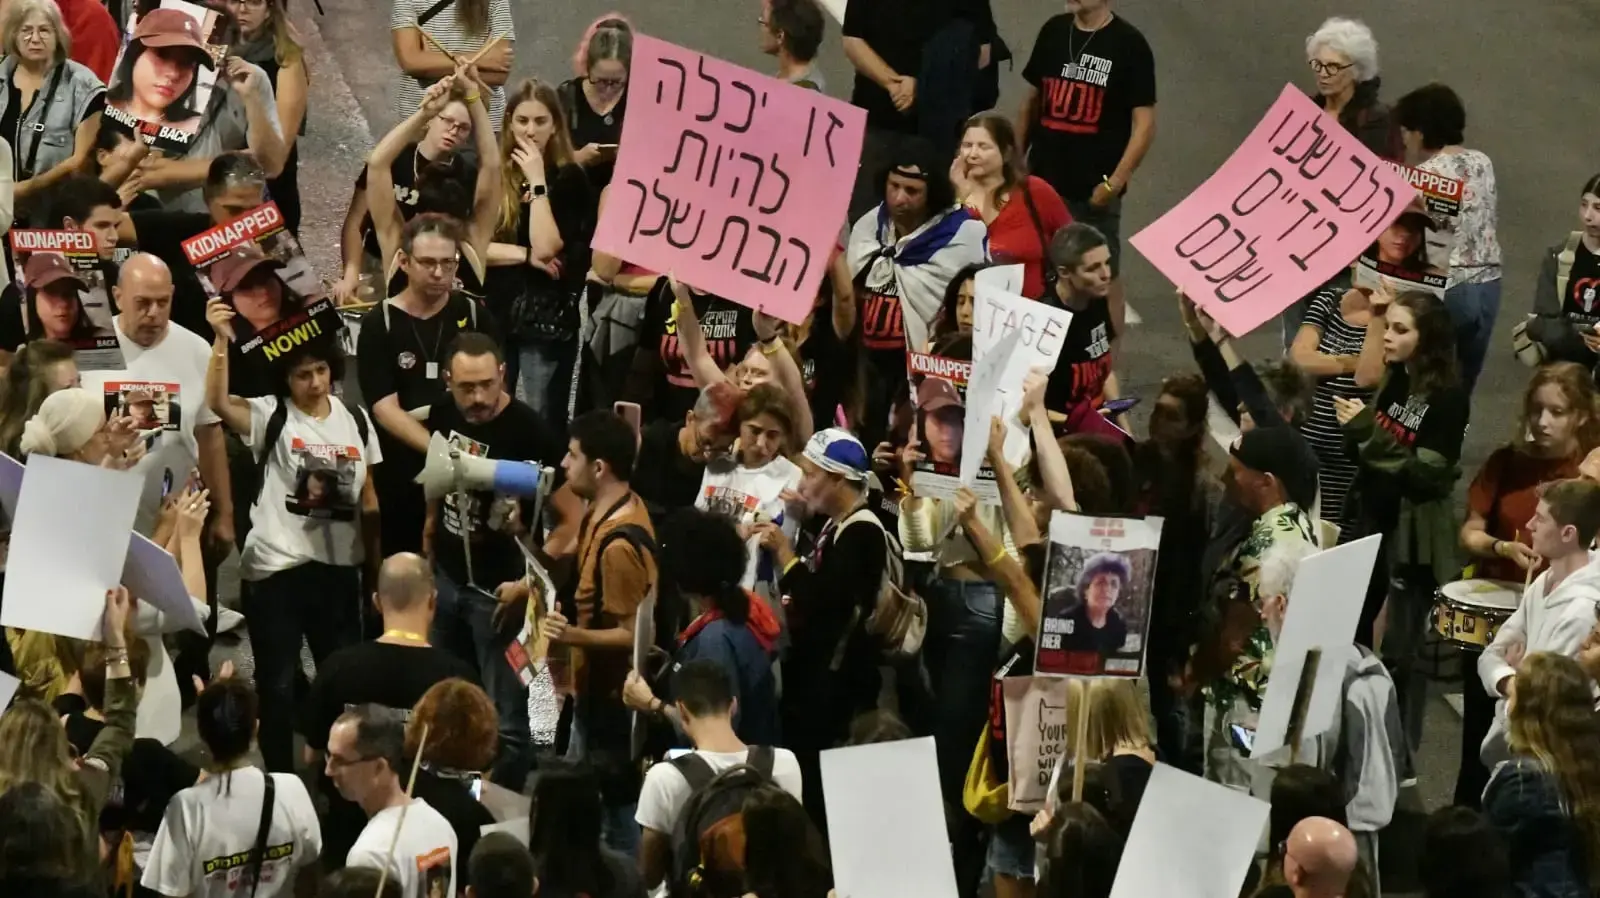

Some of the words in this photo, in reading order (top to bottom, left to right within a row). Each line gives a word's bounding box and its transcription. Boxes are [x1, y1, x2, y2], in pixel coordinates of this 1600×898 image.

[656, 56, 767, 133] יכלה
[1080, 54, 1112, 74] מחזירים
[1086, 69, 1109, 87] אותם
[104, 105, 136, 127] BRING
[159, 126, 190, 144] BACK
[1268, 110, 1342, 179] שלנו
[663, 129, 790, 214] להיות
[1321, 155, 1394, 233] הלב
[13, 231, 93, 249] KIDNAPPED
[186, 206, 279, 260] KIDNAPPED
[627, 178, 705, 249] שלך
[701, 216, 811, 291] הבת
[1175, 213, 1272, 302] שלכם
[262, 319, 322, 362] NOW!!
[910, 353, 971, 380] KIDNAPPE
